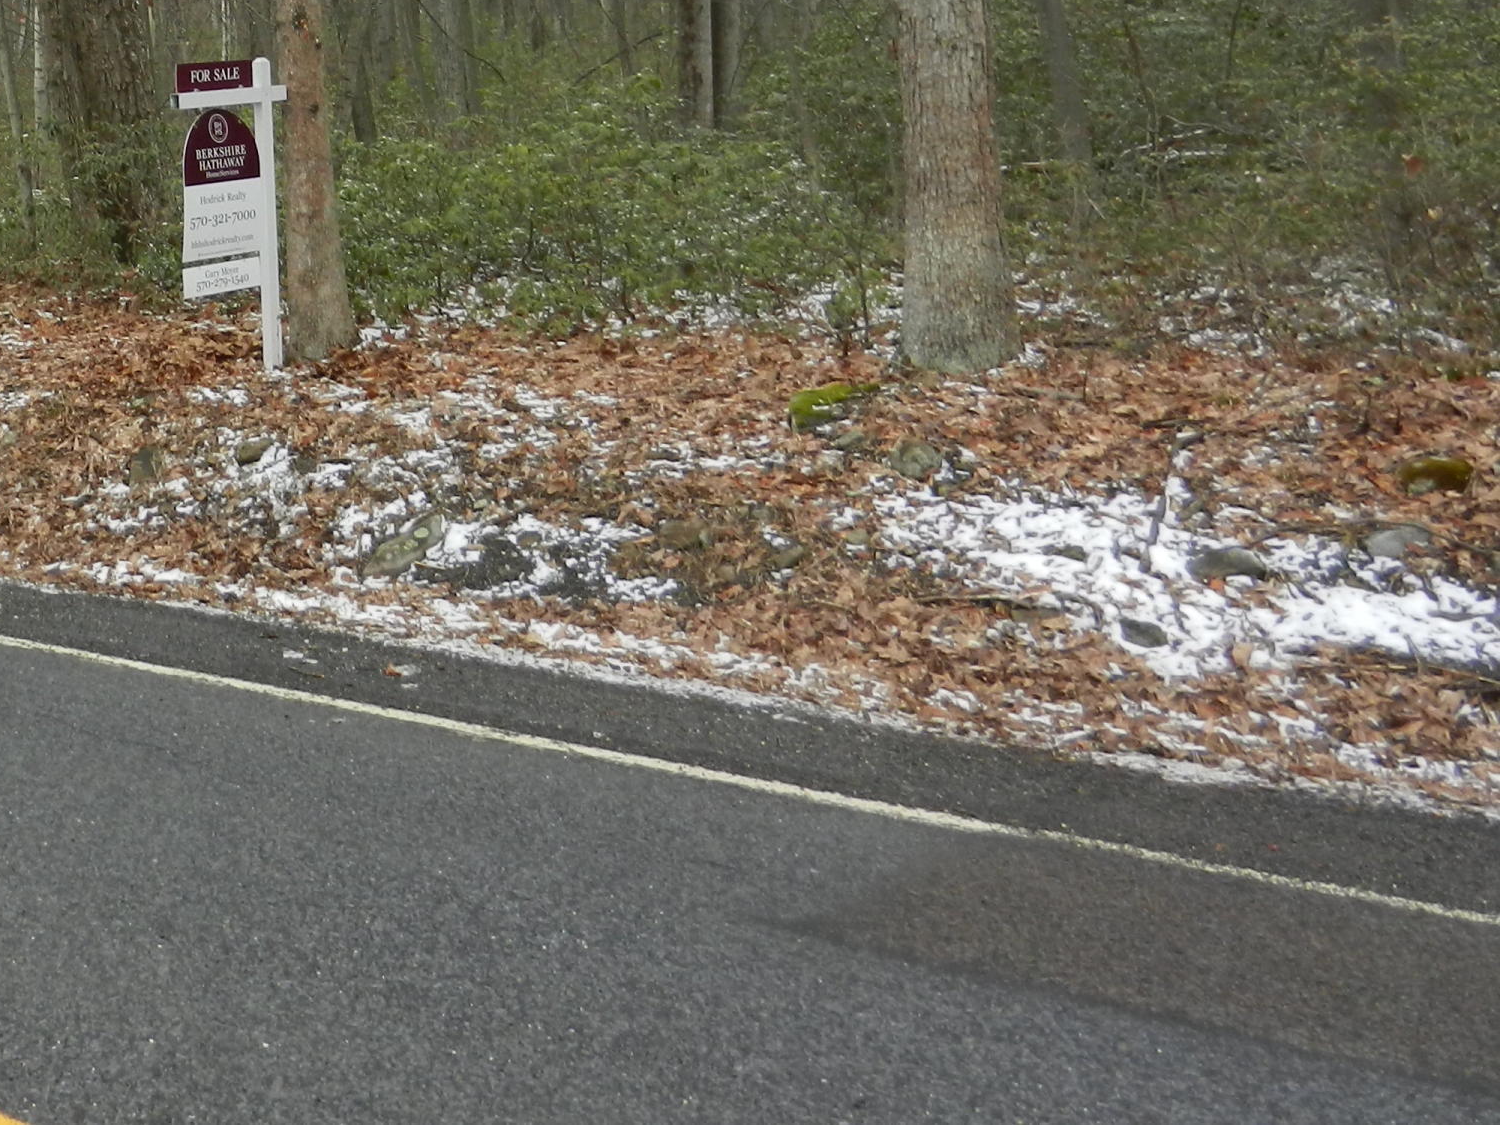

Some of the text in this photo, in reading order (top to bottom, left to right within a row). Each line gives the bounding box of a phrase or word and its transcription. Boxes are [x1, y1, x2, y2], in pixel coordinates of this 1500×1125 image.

[190, 66, 240, 83] FOR SALE
[195, 144, 247, 160] BERKSHIRE
[199, 156, 245, 171] HATHAWAY
[199, 191, 246, 205] Hodrick Realty
[189, 209, 257, 230] 570-321-7000
